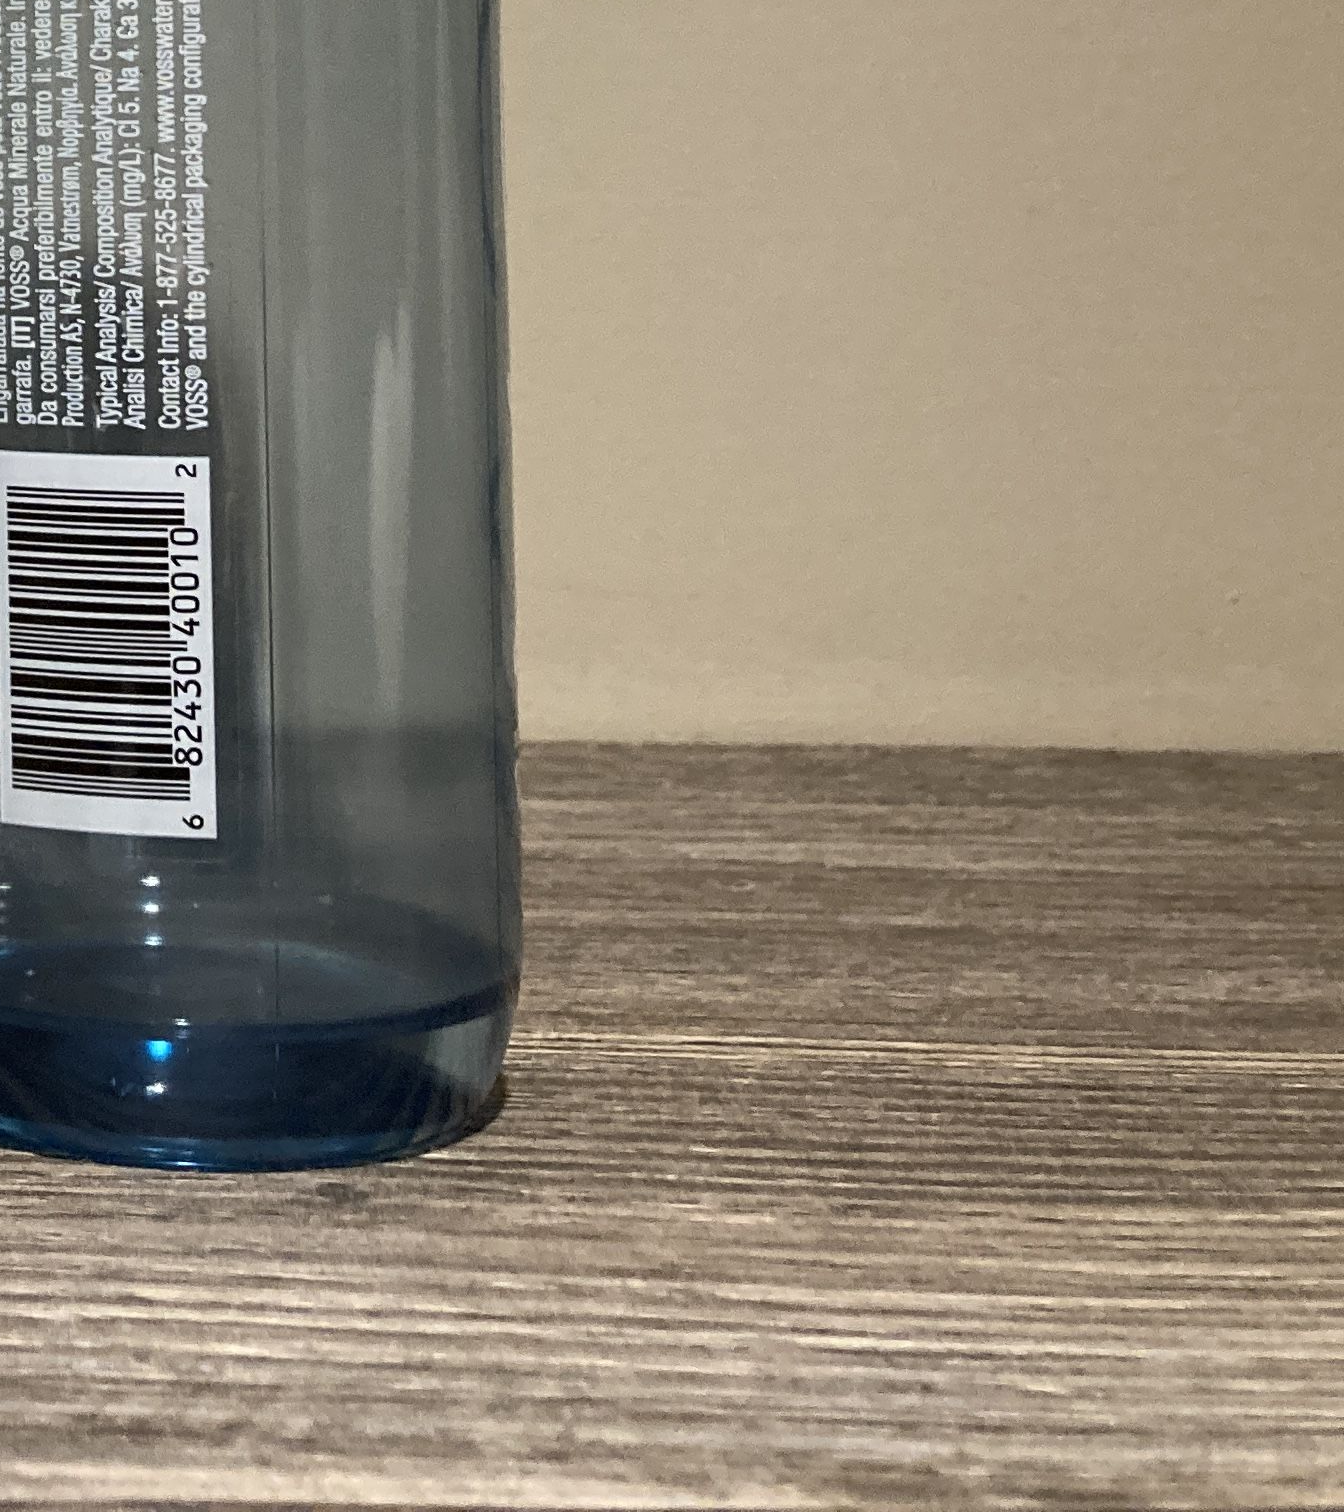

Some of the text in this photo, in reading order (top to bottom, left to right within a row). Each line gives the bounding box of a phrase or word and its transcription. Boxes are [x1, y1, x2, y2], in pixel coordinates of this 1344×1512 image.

[116, 15, 140, 39] Ca
[90, 65, 117, 164] Analytique/
[117, 66, 140, 92] Na
[180, 94, 208, 187] packaging
[93, 168, 117, 277] Composition
[183, 193, 210, 285] cylindrical
[94, 281, 121, 363] Analysis/
[121, 281, 145, 362] Chimica/
[156, 313, 180, 353] Info:
[184, 291, 206, 320] the
[184, 325, 207, 360] and
[96, 365, 122, 428] Typical
[123, 368, 146, 429] Analisi
[157, 358, 181, 429] Contact
[169, 463, 204, 830] 6 82430 40010 2
